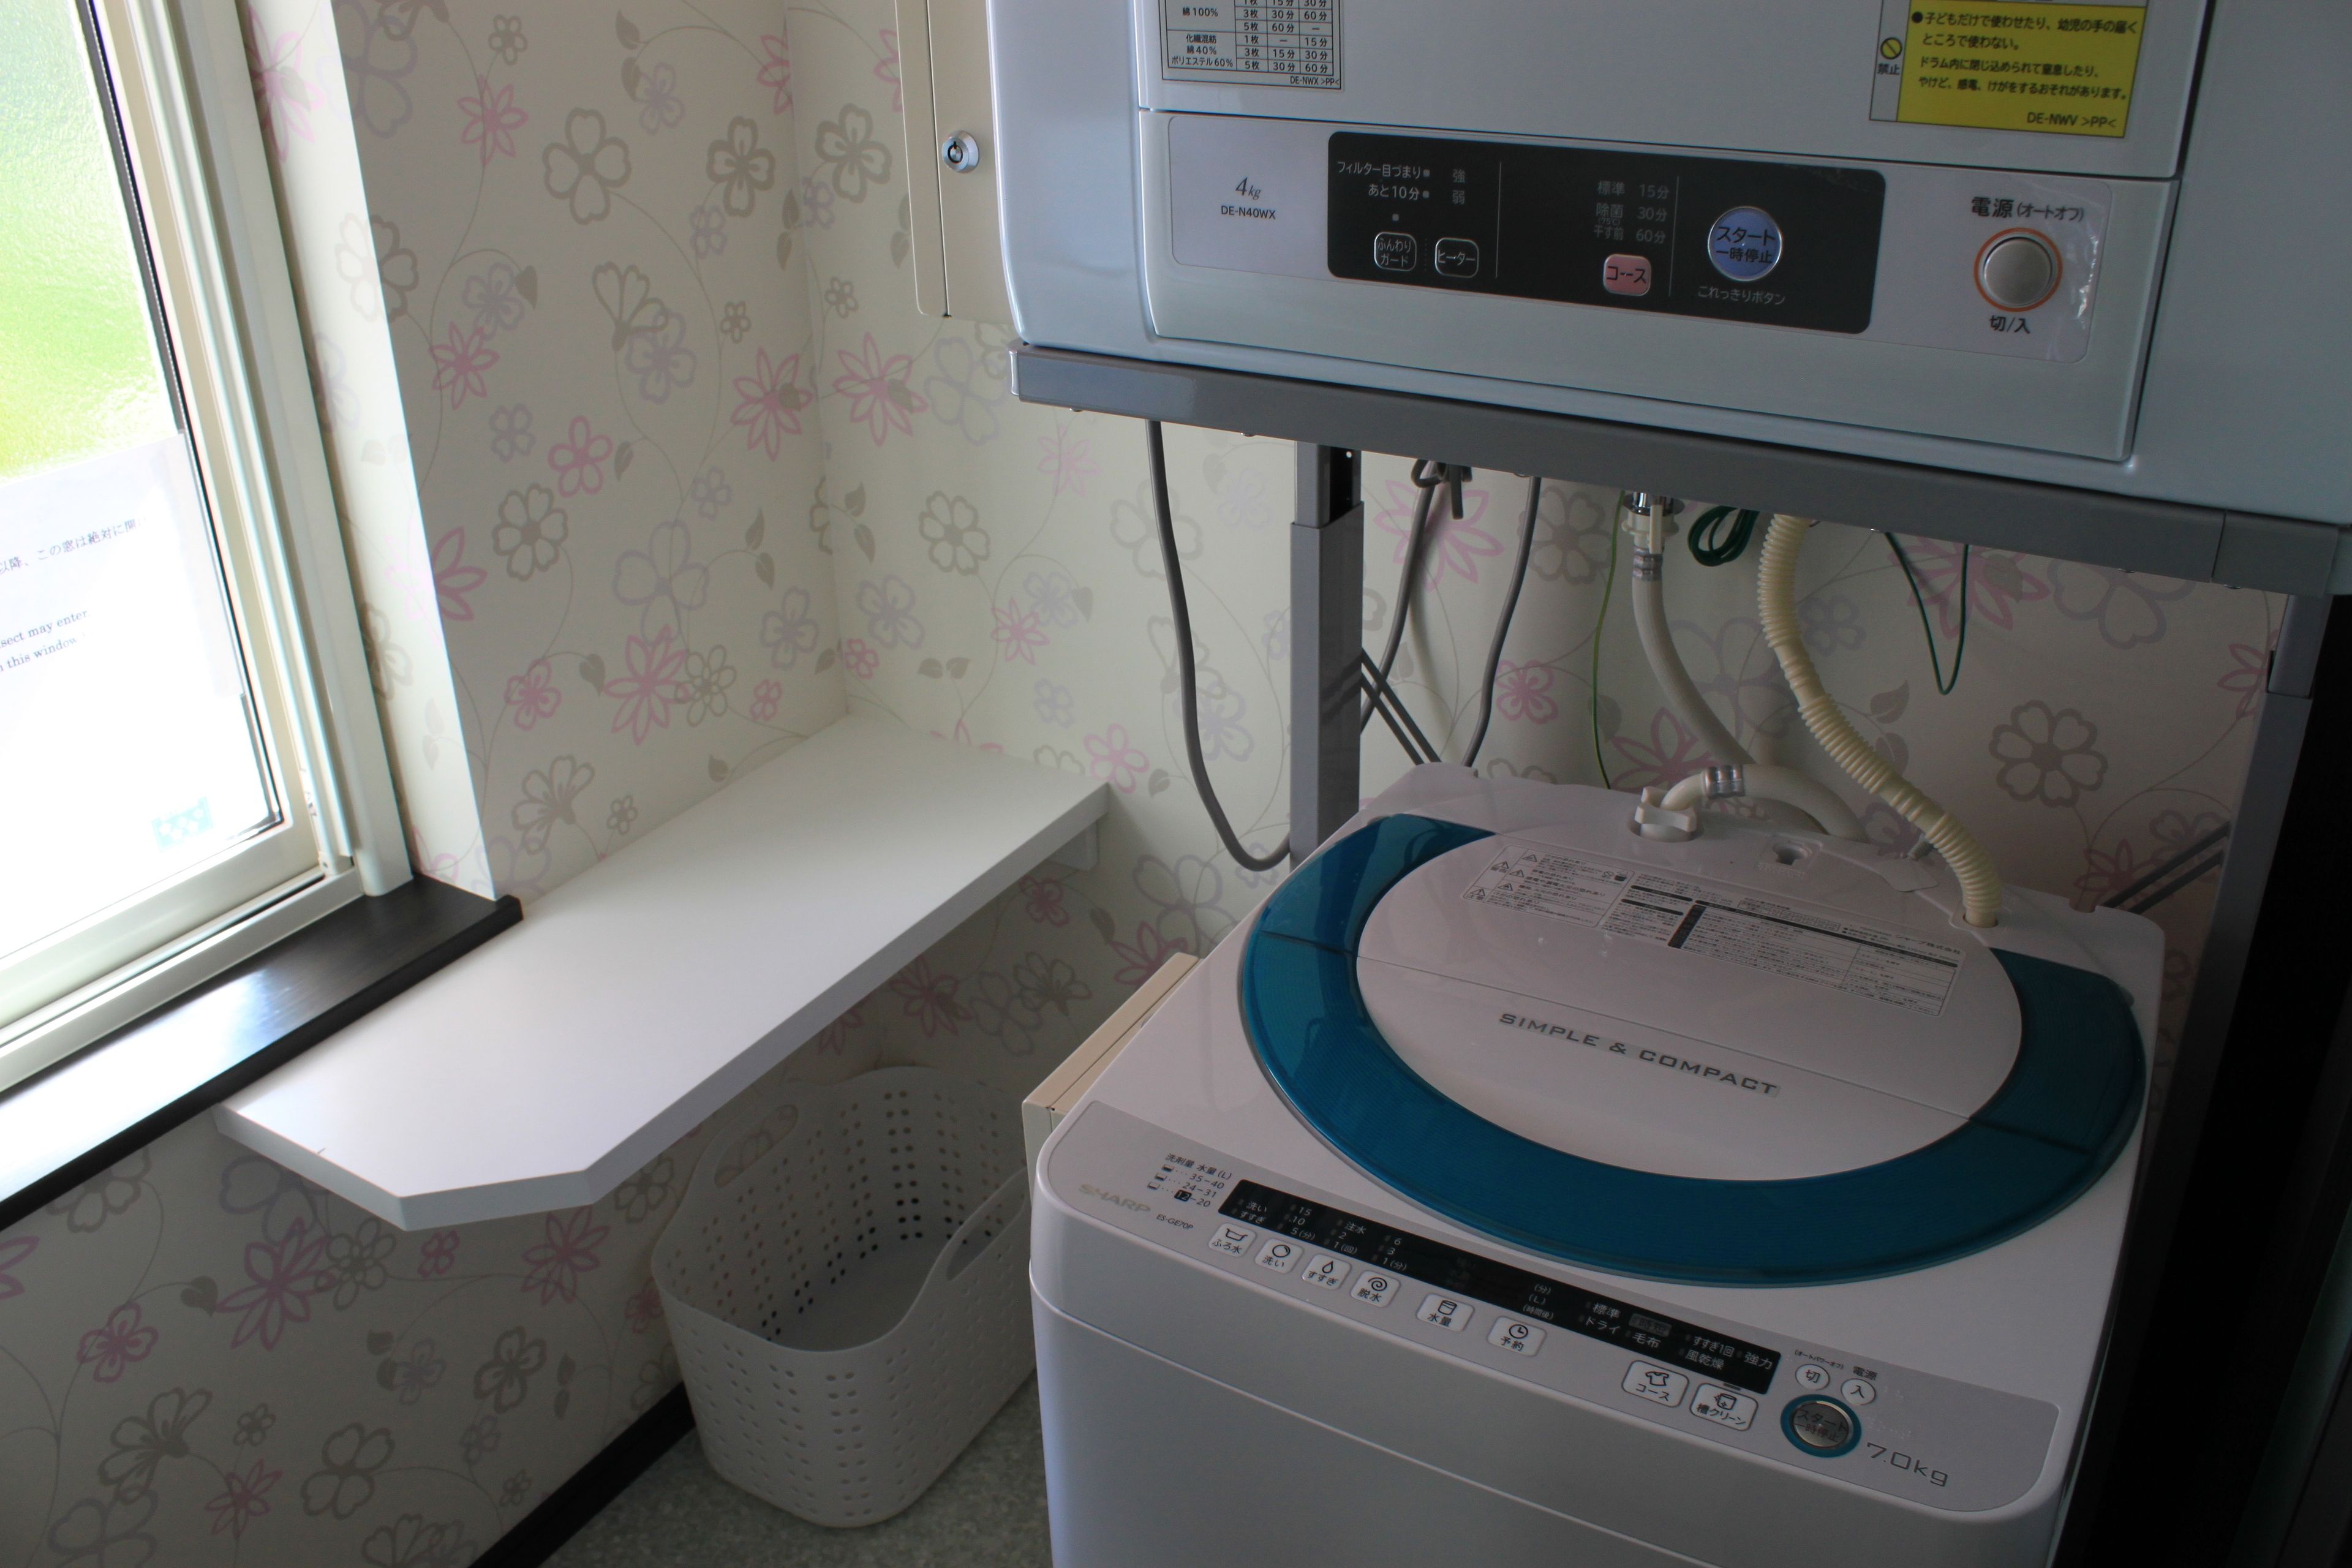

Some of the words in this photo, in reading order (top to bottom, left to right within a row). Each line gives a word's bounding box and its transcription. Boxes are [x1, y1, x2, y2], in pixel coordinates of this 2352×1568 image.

[1243, 9, 1259, 19] 3枚
[1272, 10, 1294, 20] 30分
[1304, 11, 1327, 21] 60分
[1243, 22, 1259, 32] 5枚
[1272, 23, 1294, 32] 60分
[1245, 35, 1259, 45] 1枚
[1305, 37, 1328, 48] 15分
[1922, 33, 2019, 51] ところで使わない。
[1245, 48, 1259, 58] 3枚
[1273, 49, 1295, 59] 15分
[1305, 50, 1328, 60] 30分
[1171, 58, 1233, 67] ポリエステル60%
[1245, 61, 1260, 70] 5枚
[1273, 62, 1295, 72] 30分
[1305, 63, 1329, 74] 60分
[1877, 63, 1900, 75] 禁止
[1290, 76, 1318, 85] DE-NWX
[2027, 112, 2077, 126] DE-NWV
[1338, 160, 1422, 179] フィルター目づまり
[1453, 168, 1466, 184] 強
[1368, 184, 1420, 200] あと10分
[1453, 189, 1466, 205] 弱
[1597, 180, 1626, 196] 標準
[1640, 184, 1670, 200] 15分
[1221, 205, 1276, 220] DE-N40WX
[1637, 206, 1667, 222] 30分
[1594, 224, 1624, 241] 干す前
[1636, 228, 1666, 244] 60分
[1716, 225, 1775, 246] スタート
[1377, 237, 1412, 253] ふんわり
[1381, 253, 1409, 268] ガード
[1437, 252, 1476, 266] ヒーター
[1716, 246, 1773, 264] 一時停止
[1606, 265, 1647, 284] コース
[1697, 284, 1785, 306] これっきりボタン
[1989, 314, 2031, 334] 切/入
[28, 622, 53, 638] may
[7, 654, 31, 669] this
[34, 637, 77, 659] window
[1499, 1013, 1600, 1047] SIMPLE
[1609, 1042, 1627, 1055] &
[1639, 1049, 1777, 1094] COMPACT
[1078, 1183, 1151, 1213] SHARP
[1239, 1209, 1265, 1224] すすぎ
[1299, 1207, 1311, 1216] 15
[1156, 1213, 1194, 1230] ES-GE70P
[1212, 1238, 1241, 1254] ふろ水
[1262, 1254, 1285, 1268] 洗い
[1307, 1269, 1340, 1286] すすぎ
[1357, 1288, 1382, 1303] 脱水
[1585, 1316, 1621, 1335] ドライ
[1500, 1336, 1525, 1351] 予約
[1632, 1332, 1662, 1348] 毛布
[1805, 1369, 1821, 1384] 切
[1635, 1382, 1670, 1402] コース
[1850, 1385, 1865, 1399] 入
[1797, 1409, 1848, 1433] スタート
[1866, 1441, 1948, 1487] 7.0kg
